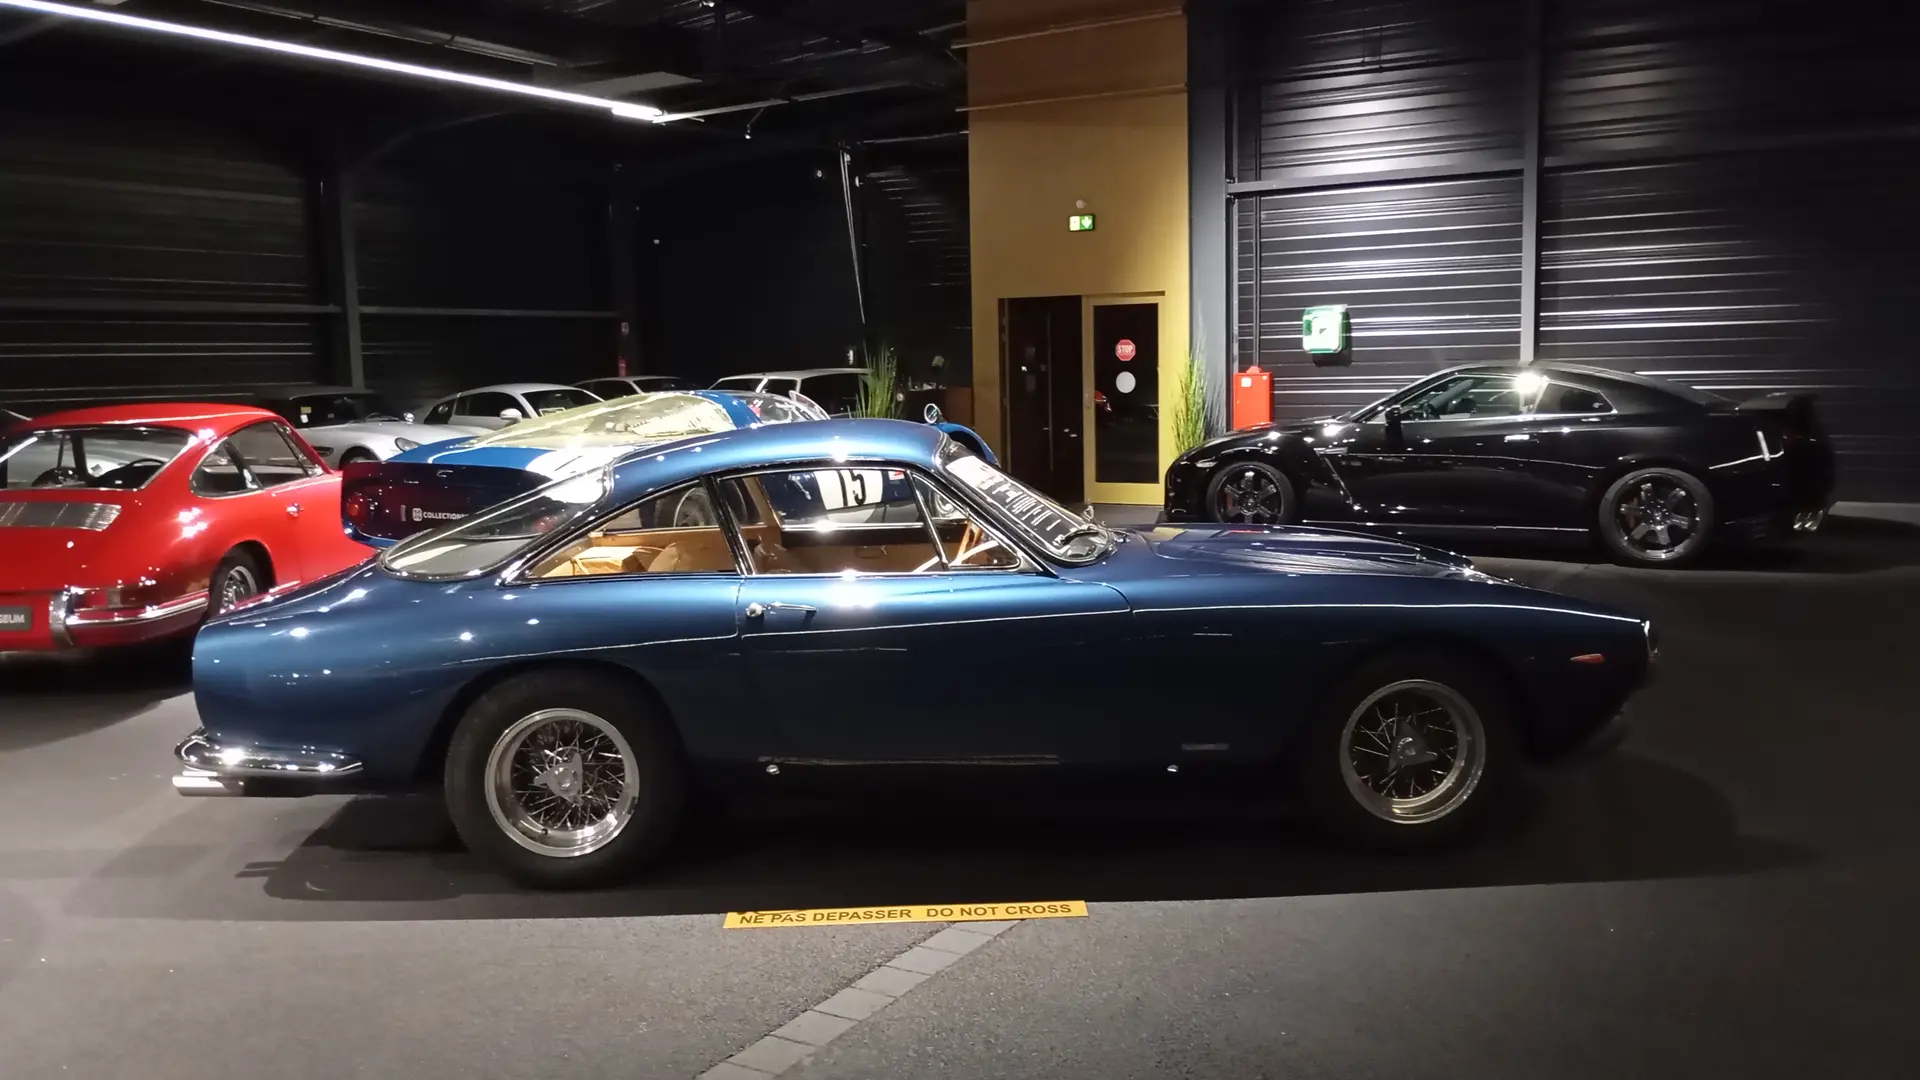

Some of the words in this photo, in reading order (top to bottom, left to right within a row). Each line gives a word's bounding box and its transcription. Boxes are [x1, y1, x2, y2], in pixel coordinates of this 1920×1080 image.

[1117, 344, 1134, 354] STOP
[836, 469, 867, 507] 15
[739, 914, 764, 924] NE
[770, 913, 807, 923] PAS
[812, 909, 912, 922] DEPASSER
[926, 908, 954, 918] DO
[960, 906, 998, 917] NOT
[1005, 904, 1072, 915] CROSS
